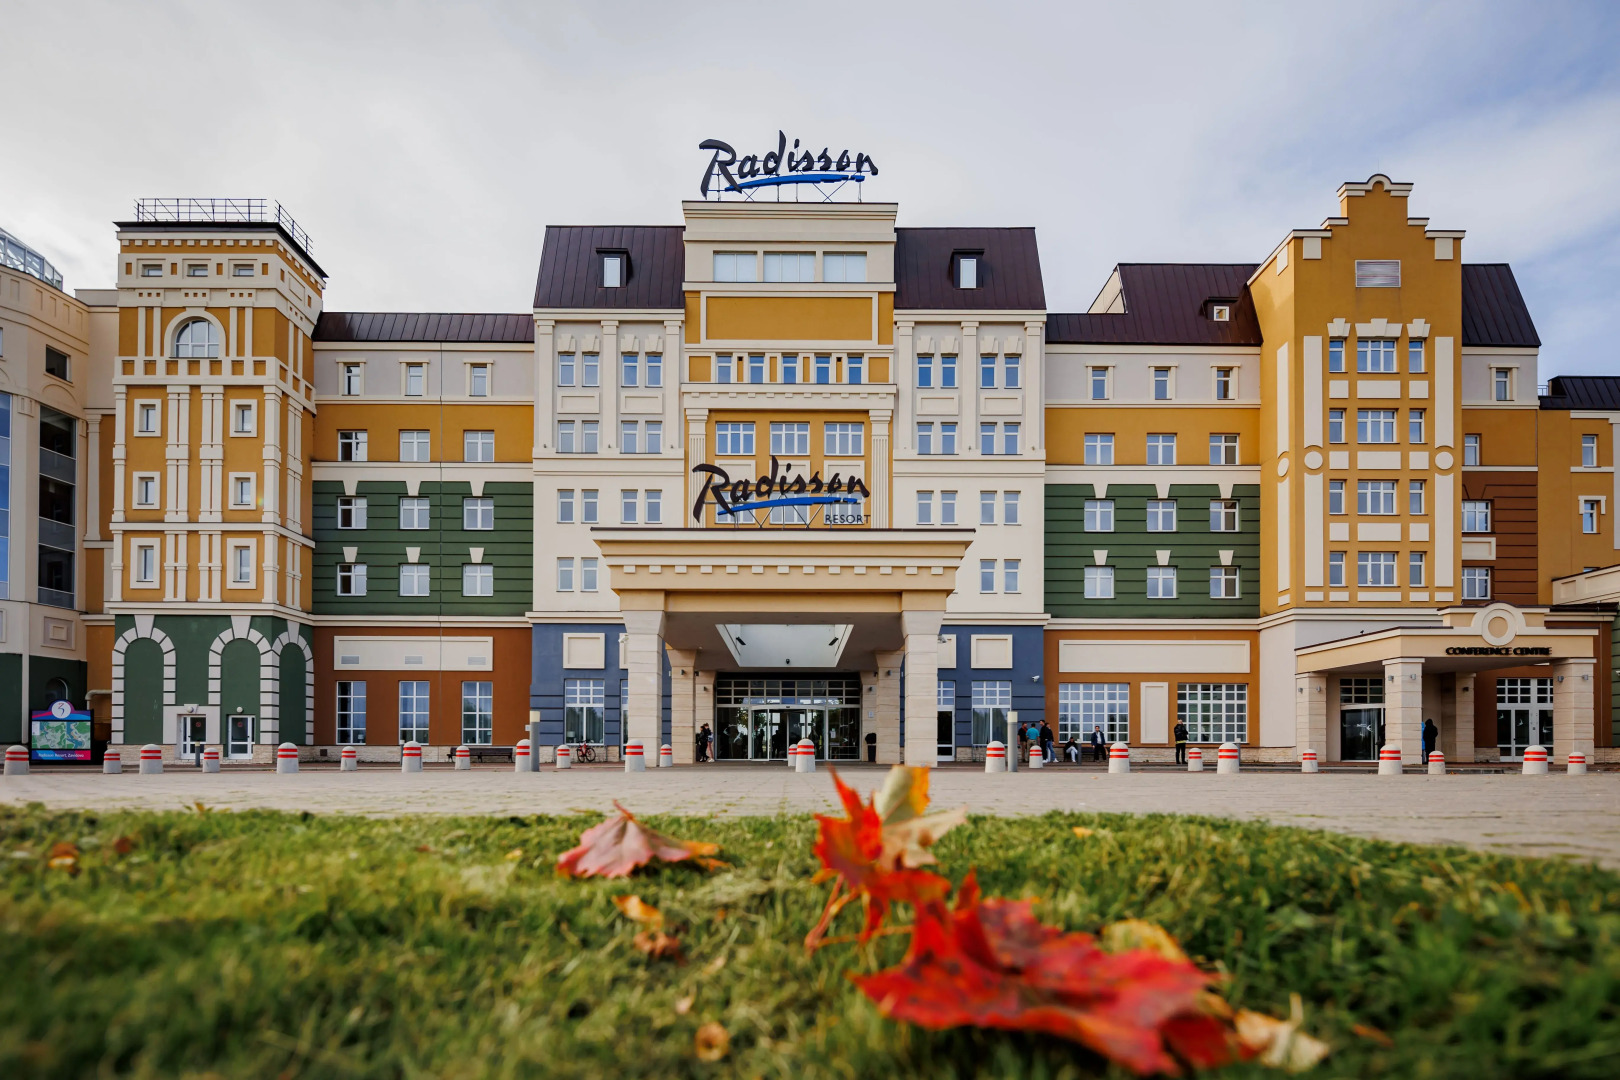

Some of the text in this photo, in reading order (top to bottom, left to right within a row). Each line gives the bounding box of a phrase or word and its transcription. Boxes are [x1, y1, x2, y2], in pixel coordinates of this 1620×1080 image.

[699, 130, 878, 200] Radisson
[692, 455, 870, 523] Radisson
[825, 514, 871, 524] RESORT
[1445, 646, 1552, 656] CONFERENCE CENTRE
